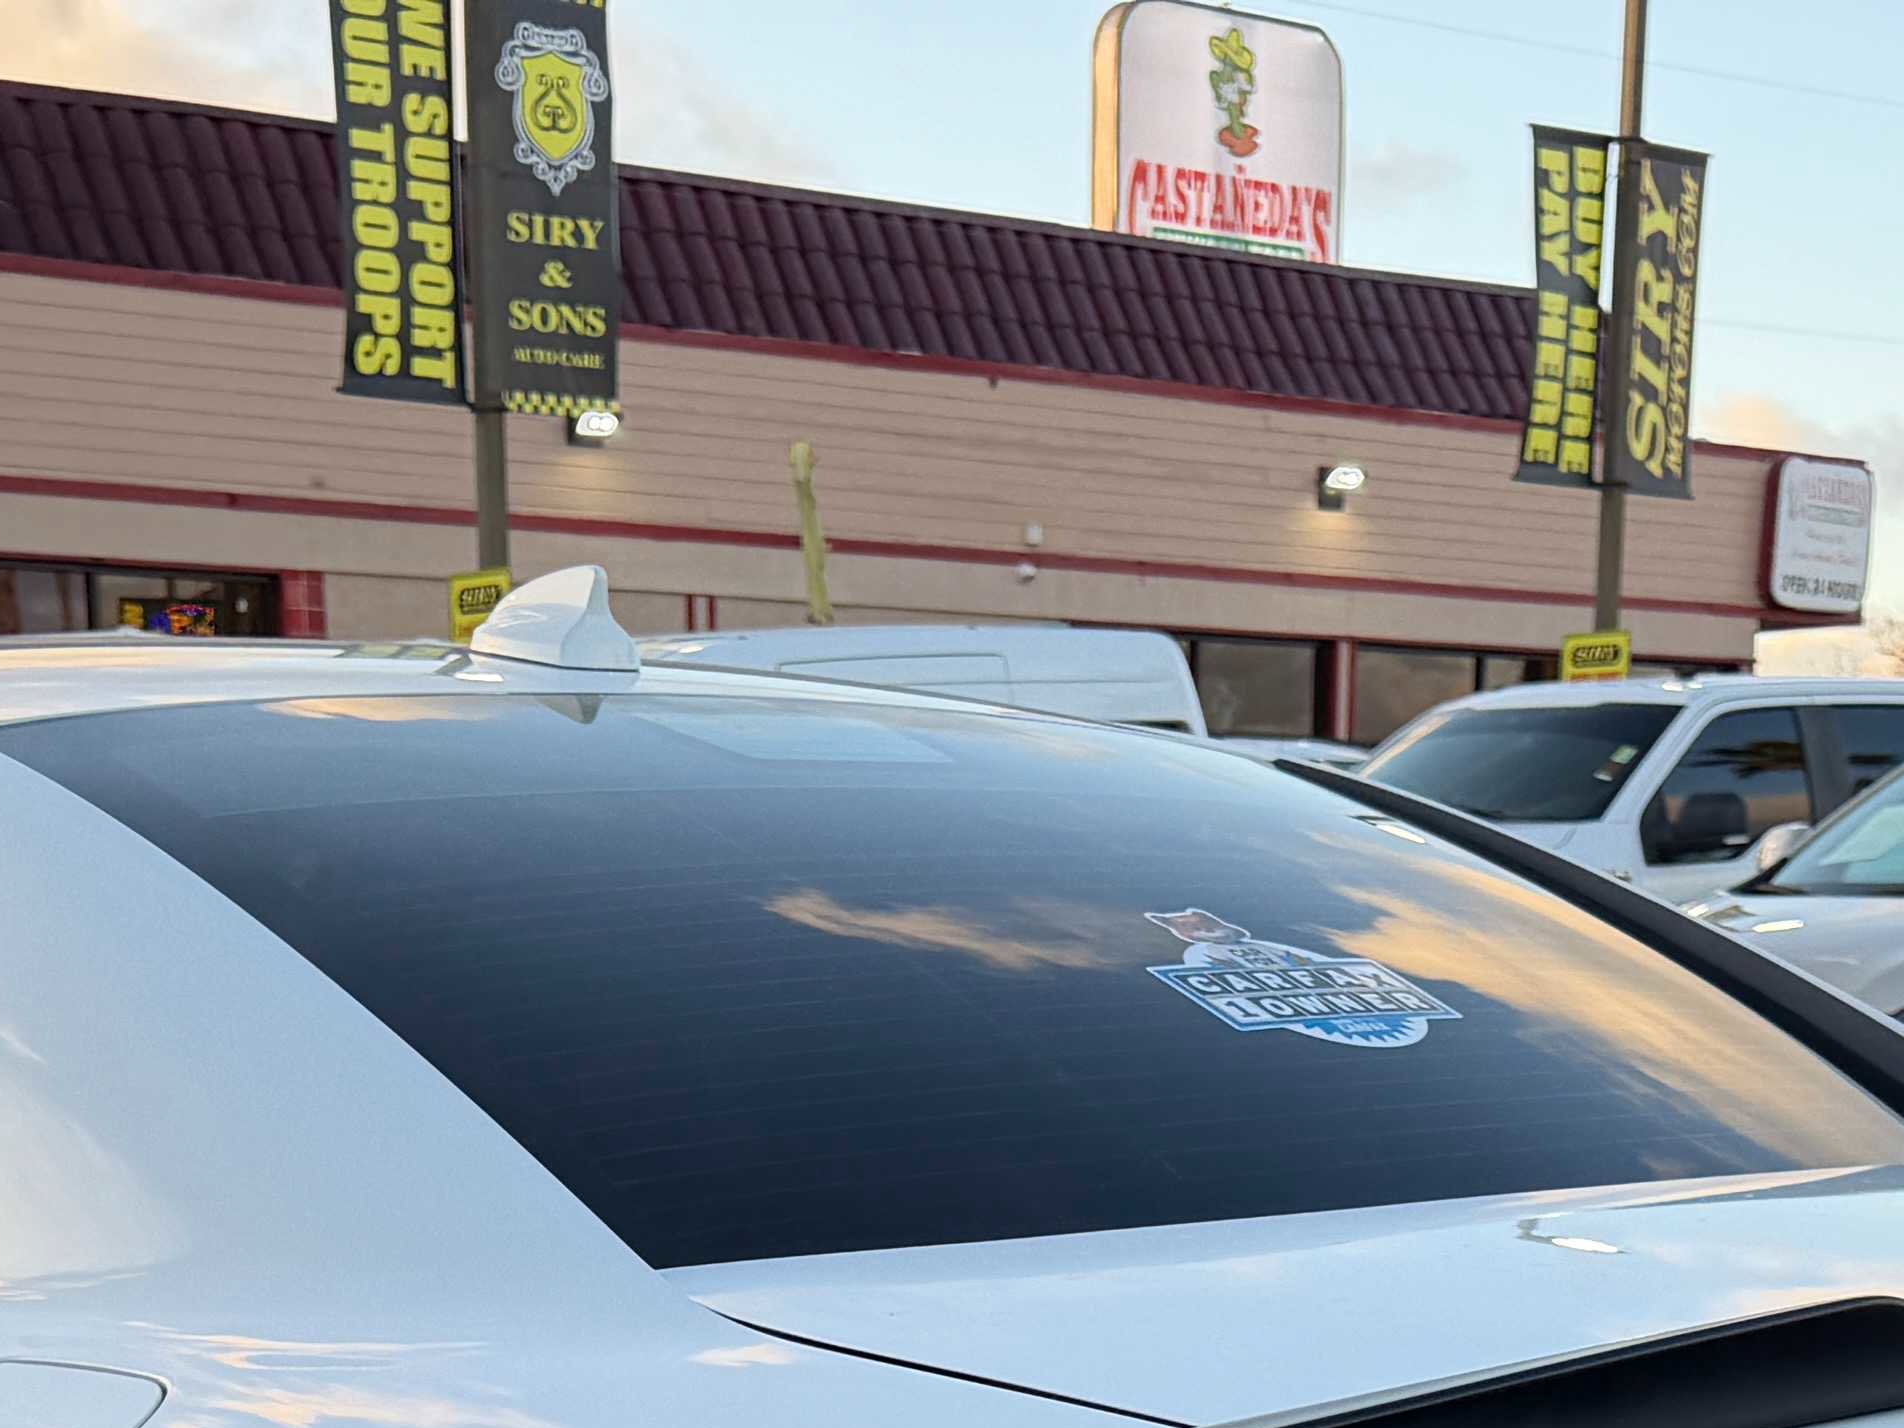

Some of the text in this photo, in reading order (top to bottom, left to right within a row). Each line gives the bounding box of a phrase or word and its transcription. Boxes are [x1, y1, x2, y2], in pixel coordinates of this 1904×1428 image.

[348, 123, 402, 377] TROOPS
[402, 92, 456, 389] SUPPORT
[506, 211, 604, 251] SIRY
[538, 259, 574, 289] &
[508, 298, 607, 338] SONS
[1523, 147, 1570, 465] PAY HERE
[1557, 145, 1604, 475] BUY HERE
[1626, 158, 1679, 480] SIRY
[1184, 968, 1393, 994] CARFAX
[1263, 991, 1437, 1017] OWNER
